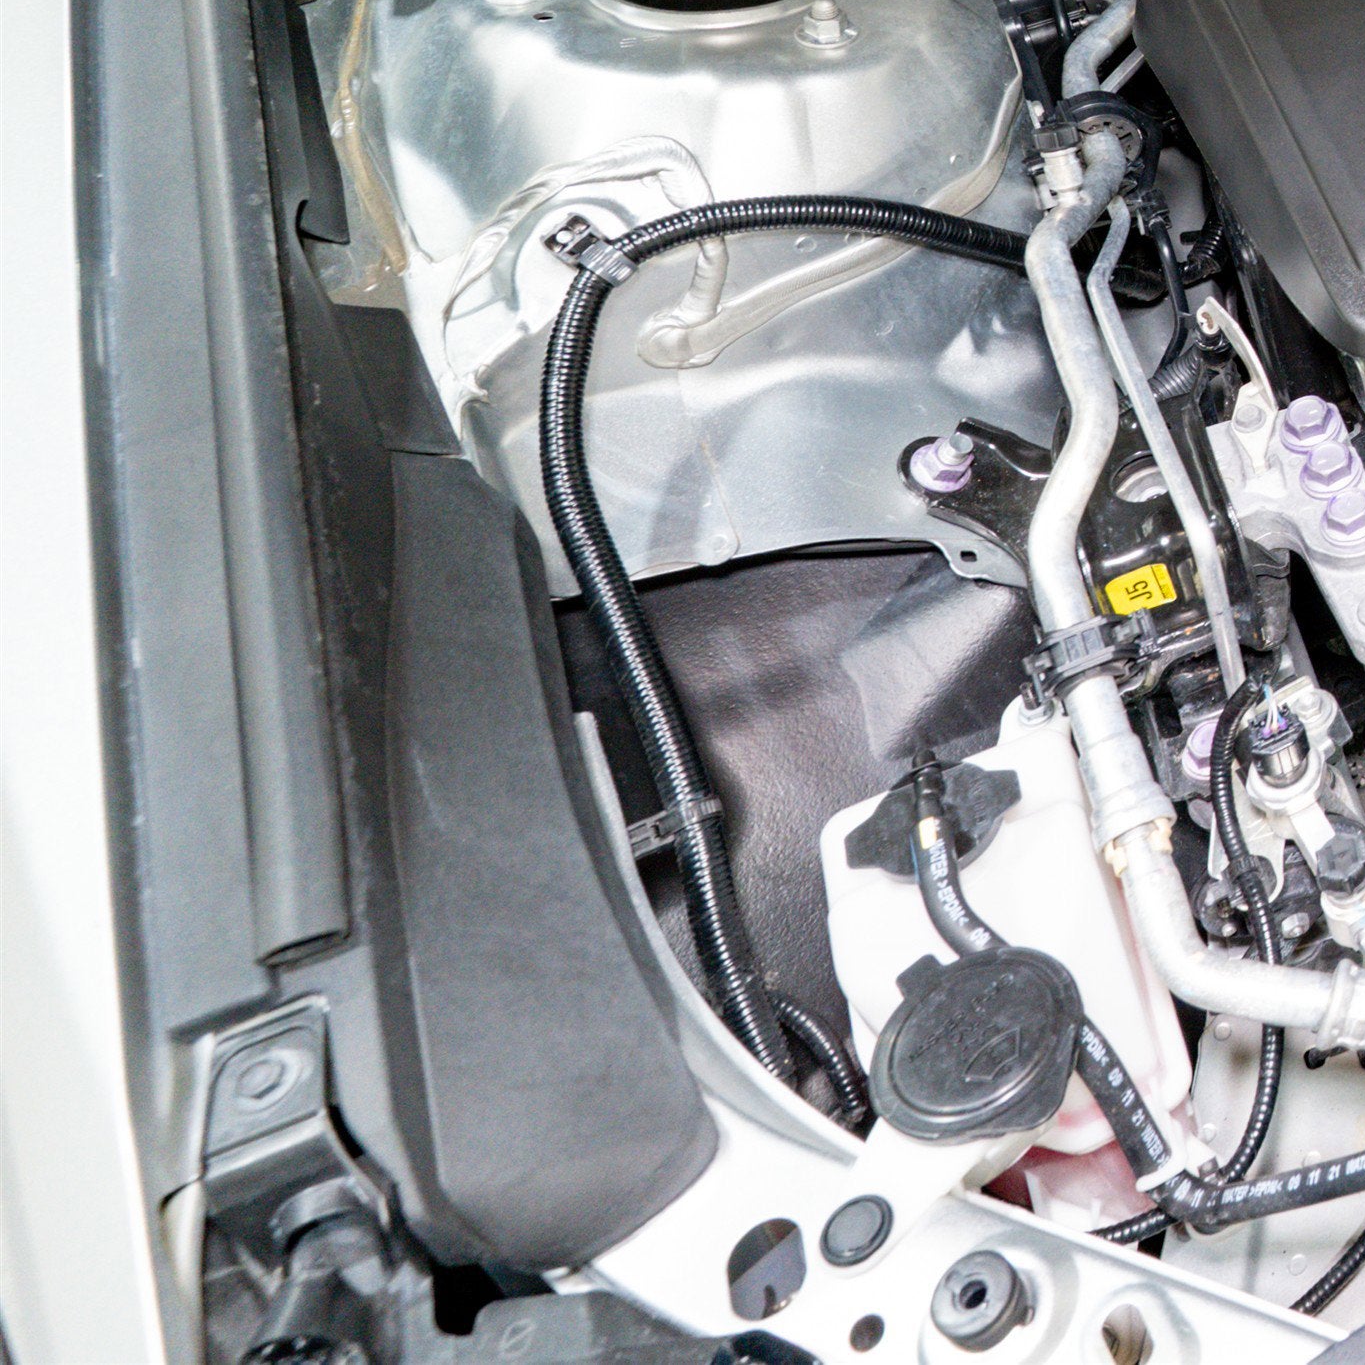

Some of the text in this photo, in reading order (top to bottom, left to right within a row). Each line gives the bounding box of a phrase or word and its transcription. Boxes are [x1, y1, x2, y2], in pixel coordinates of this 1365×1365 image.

[1125, 580, 1153, 601] J5
[928, 838, 948, 881] WATER
[1140, 1123, 1166, 1159] WATER
